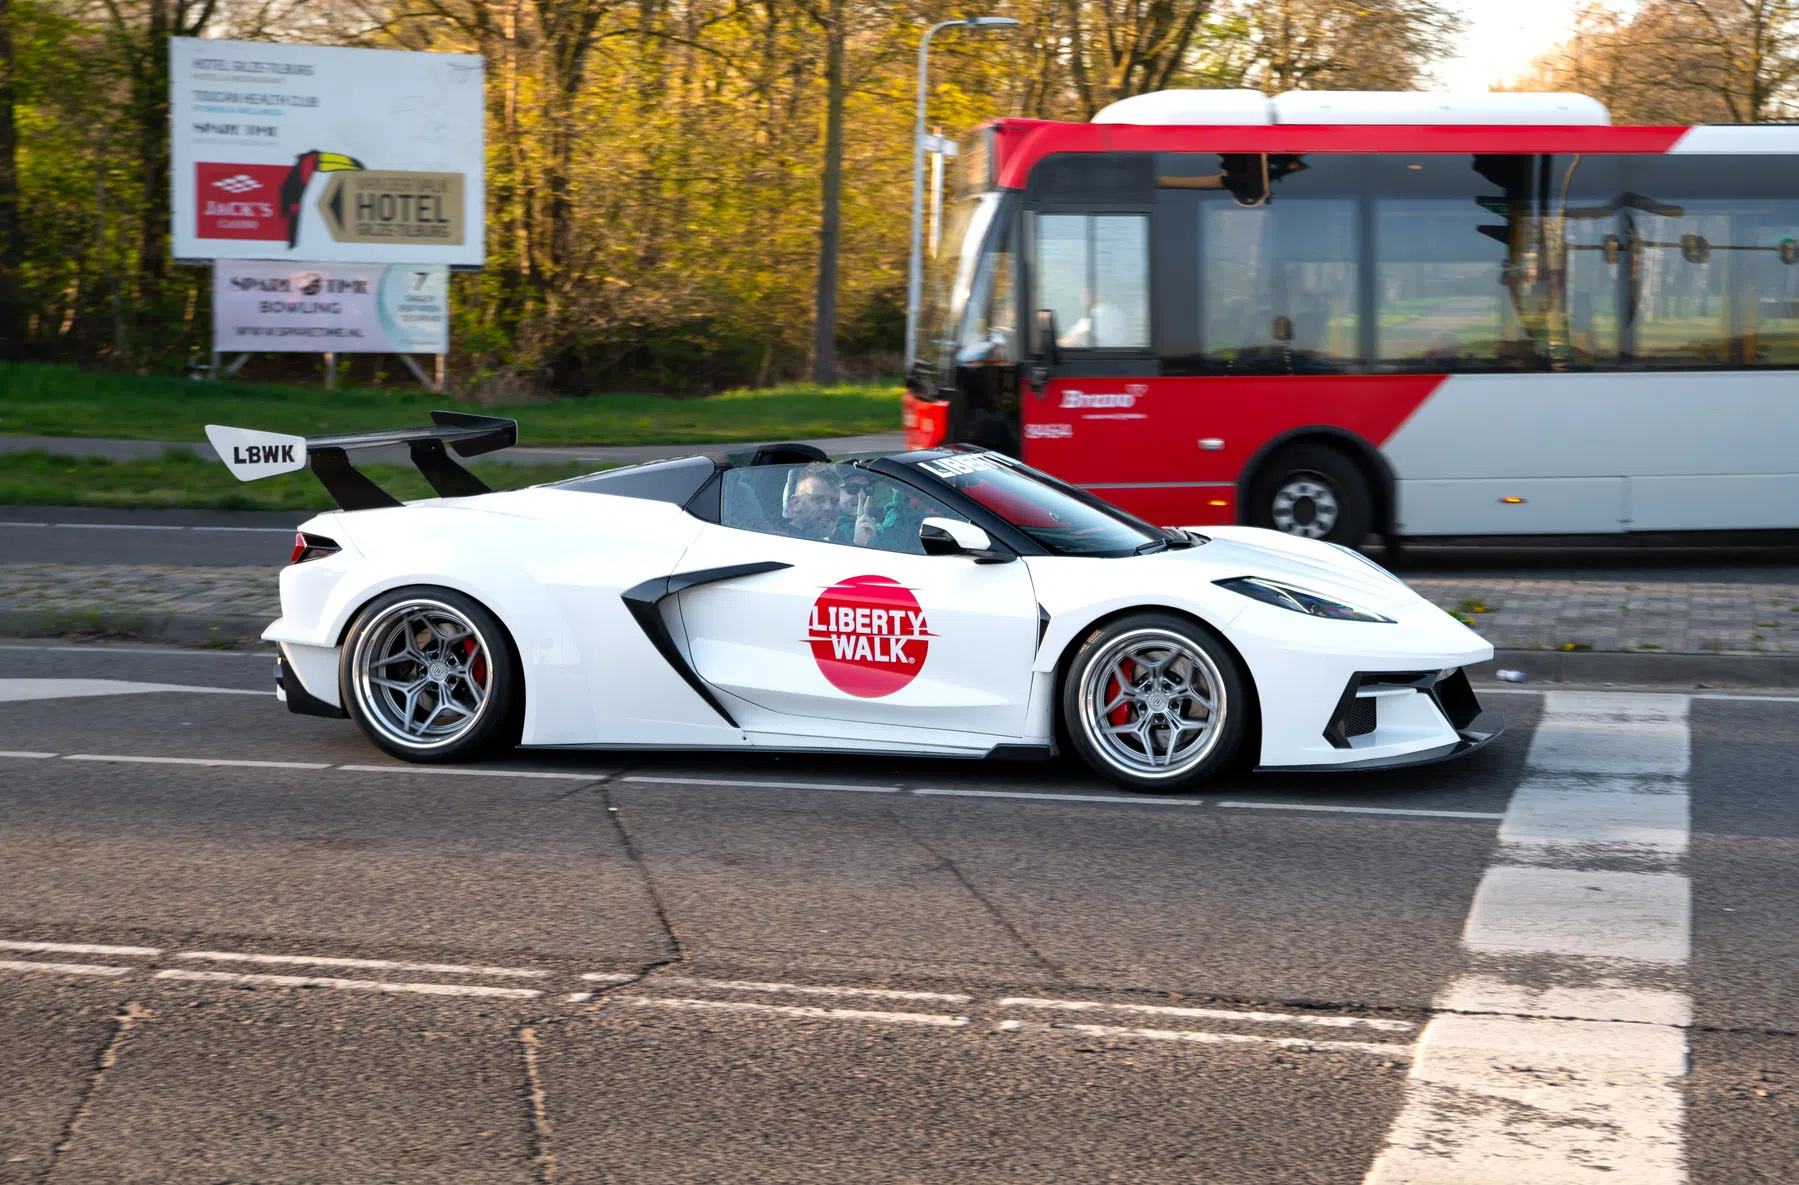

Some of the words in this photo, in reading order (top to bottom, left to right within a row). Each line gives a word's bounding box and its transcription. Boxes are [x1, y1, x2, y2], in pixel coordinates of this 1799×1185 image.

[191, 122, 240, 136] SPARE
[243, 125, 279, 137] TIME
[203, 200, 274, 217] JACK'S
[356, 193, 451, 223] HOTEL
[228, 277, 291, 292] SPARE
[326, 279, 368, 294] TIME
[411, 271, 430, 292] 7
[259, 301, 342, 314] BOWLING
[233, 445, 295, 464] LBWK
[917, 451, 1013, 479] LIBERTY
[811, 605, 924, 637] LIBERTY
